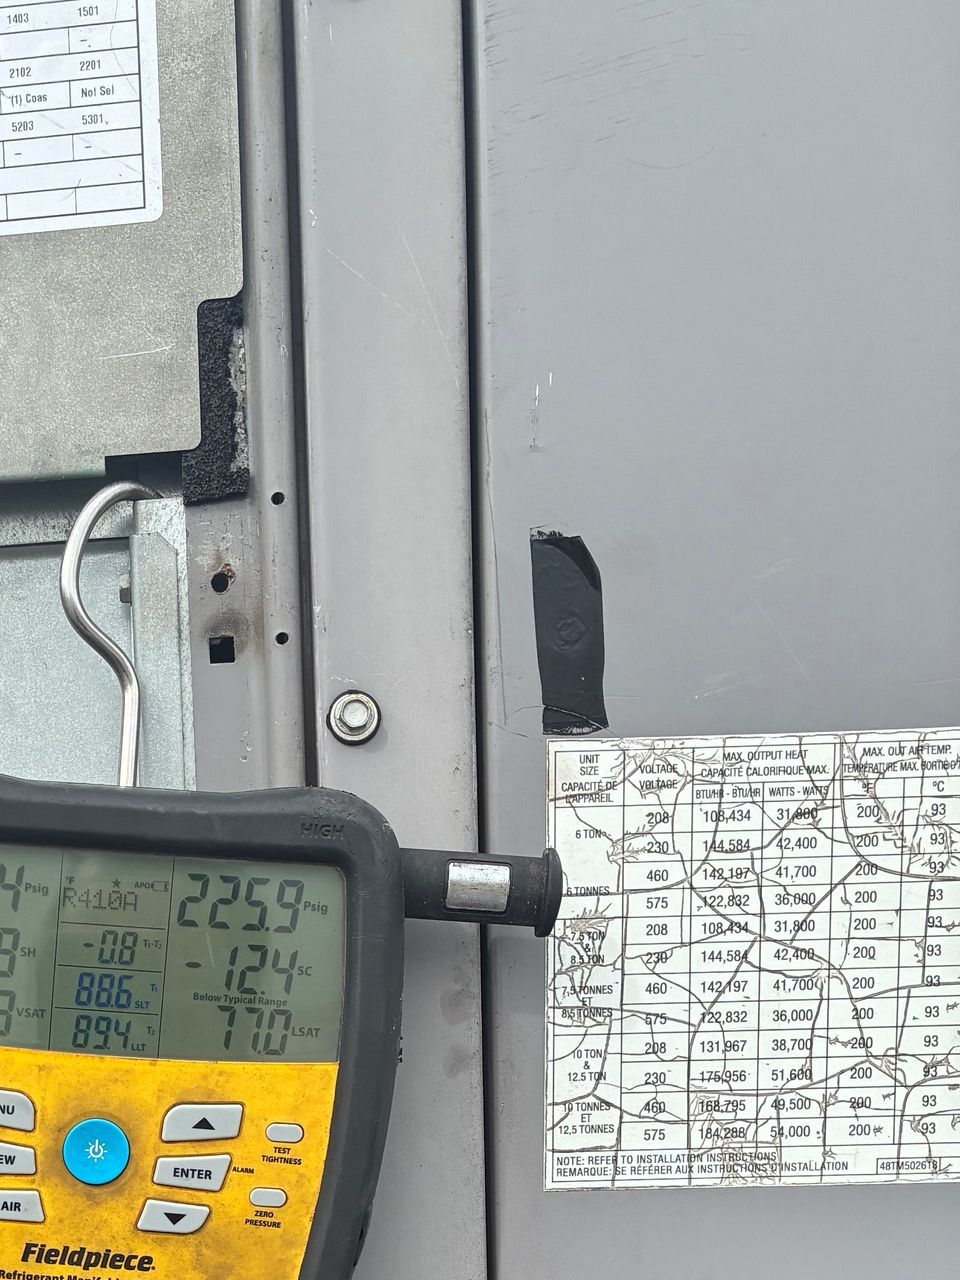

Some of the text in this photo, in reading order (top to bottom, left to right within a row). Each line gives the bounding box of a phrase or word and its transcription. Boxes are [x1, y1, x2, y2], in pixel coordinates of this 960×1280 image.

[7, 14, 29, 24] 1403
[78, 6, 99, 18] 1501
[10, 67, 32, 78] 2102
[80, 60, 102, 72] 2201
[81, 86, 98, 98] Not
[100, 84, 115, 96] Sel
[12, 121, 34, 132] 5203
[82, 114, 104, 126] 5301
[724, 749, 808, 762] MAX. OUTPUT HEAT
[862, 747, 886, 757] MAX.
[888, 746, 908, 756] OUT
[580, 754, 600, 764] UNIT
[580, 766, 600, 776] SIZE
[640, 764, 678, 774] VOLTAGE
[746, 765, 804, 777] CALORIFIQUE
[768, 787, 795, 797] WATTS
[647, 803, 946, 824] 208 200 93
[300, 823, 345, 840] HIGH
[776, 837, 818, 851] 42,400
[646, 865, 817, 882] 460 41,700
[24, 882, 49, 896] Psig
[62, 887, 138, 911] R410A
[176, 873, 329, 934] 225.9 Psig
[646, 890, 878, 910] 575 36,000 200
[646, 924, 668, 936] 208
[20, 947, 37, 958] SH
[297, 966, 312, 976] SC
[75, 972, 134, 1009] 88.6
[645, 979, 814, 994] 460 41,700
[134, 1001, 151, 1010] SLT
[193, 992, 288, 1008] Below Typical Range
[16, 1007, 46, 1019] VSAT
[72, 1014, 132, 1050] 89.4
[217, 1004, 320, 1056] 77.0 LSAT
[131, 1043, 146, 1052] LLT
[644, 1126, 810, 1141] 575 54,000
[273, 1146, 292, 1155] TEST
[262, 1155, 302, 1166] TIGHTNESS
[556, 1156, 585, 1166] NOTE:
[620, 1154, 634, 1164] TO
[173, 1168, 212, 1180] ENTER
[232, 1166, 254, 1174] ALARM
[556, 1166, 612, 1177] REMARQUE:
[0, 1201, 22, 1212] AIR
[254, 1210, 274, 1218] ZERO
[244, 1218, 282, 1228] PRESSURE
